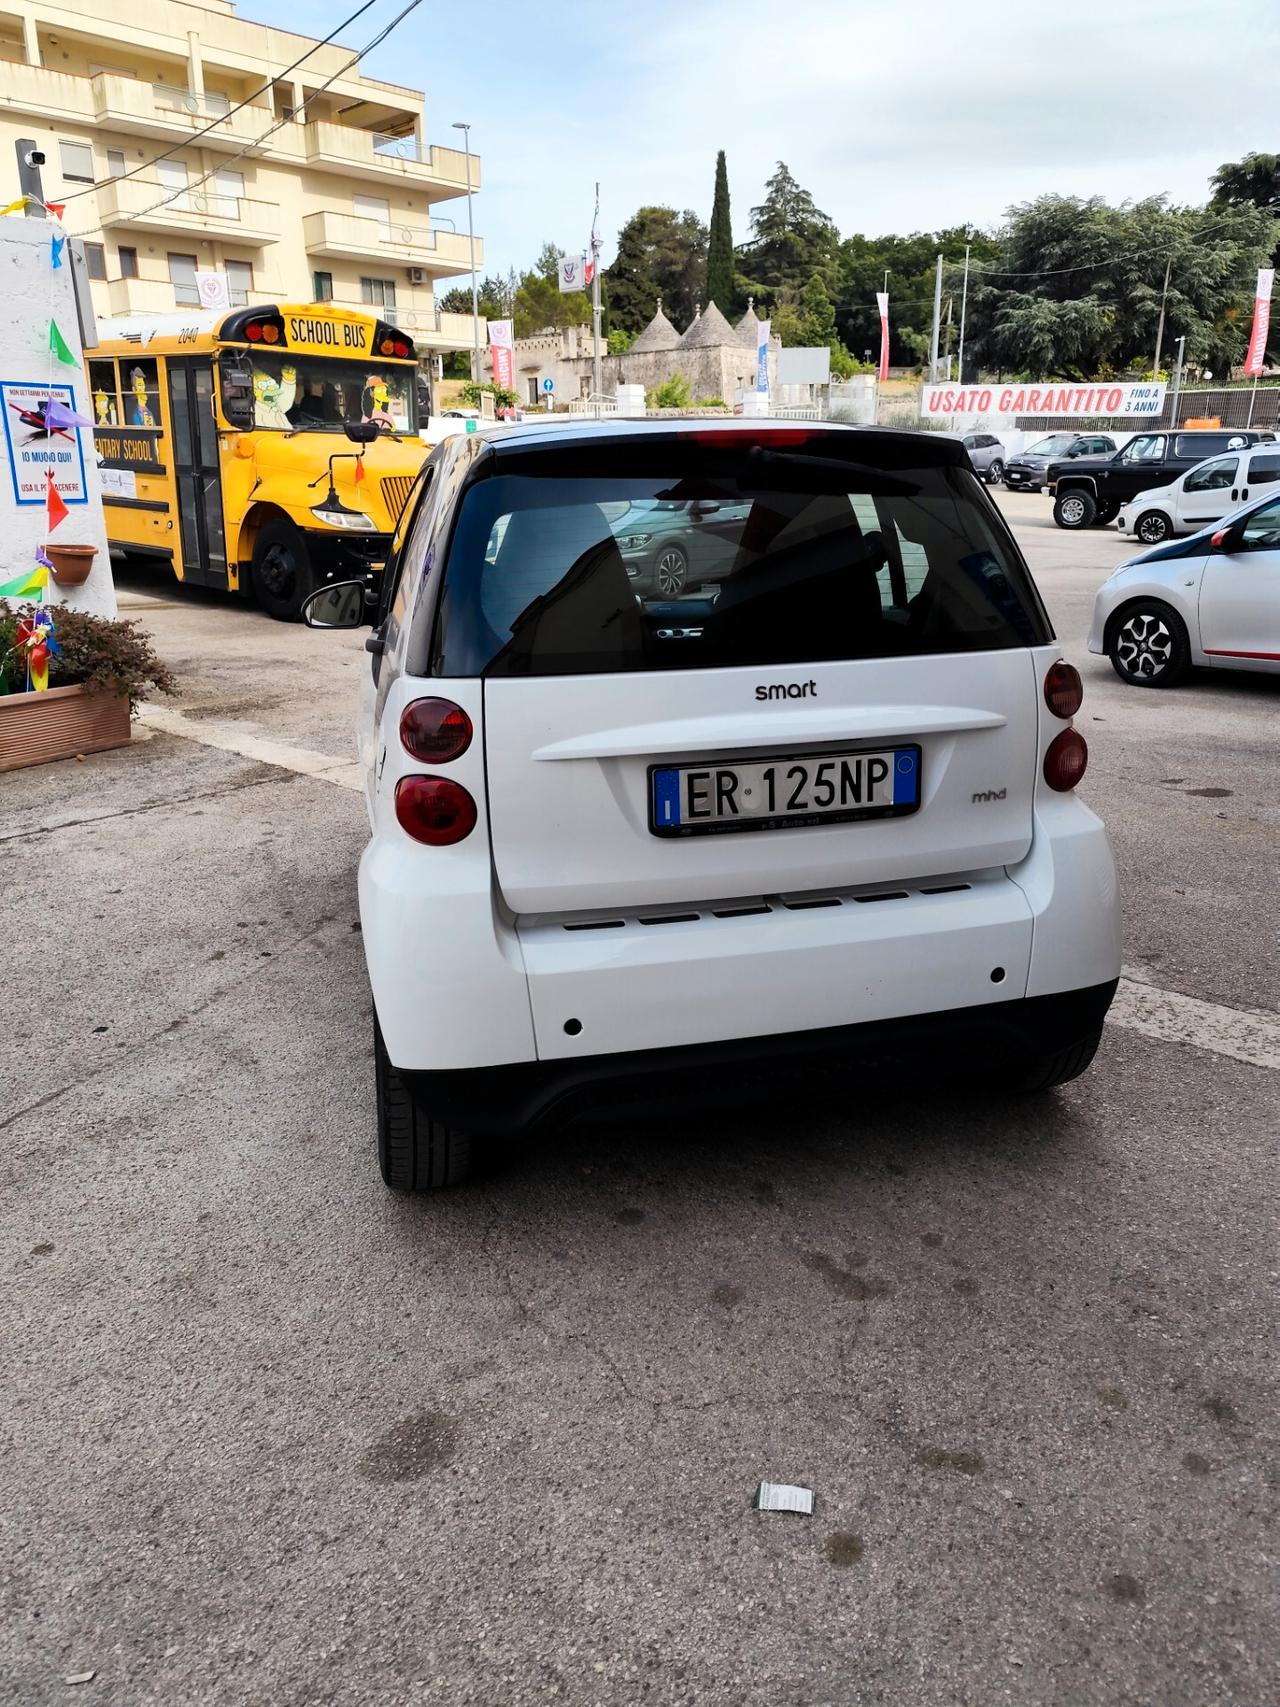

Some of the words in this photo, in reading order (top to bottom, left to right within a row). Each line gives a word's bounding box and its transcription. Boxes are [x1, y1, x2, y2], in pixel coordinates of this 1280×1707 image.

[177, 327, 199, 344] 2040
[290, 318, 339, 346] SCHOOL
[344, 324, 366, 349] BUS
[928, 389, 993, 412] USATO
[999, 388, 1123, 412] GARANTITO
[1129, 388, 1151, 399] FINO
[1152, 388, 1159, 398] A
[1124, 403, 1131, 412] 3
[1132, 401, 1158, 412] ANNI
[21, 452, 30, 462] IO
[123, 439, 153, 461] SCHOOL
[21, 484, 32, 492] USA
[755, 680, 817, 700] smart
[687, 770, 739, 818] ER
[762, 757, 888, 811] 125NP
[972, 788, 1007, 804] mhd
